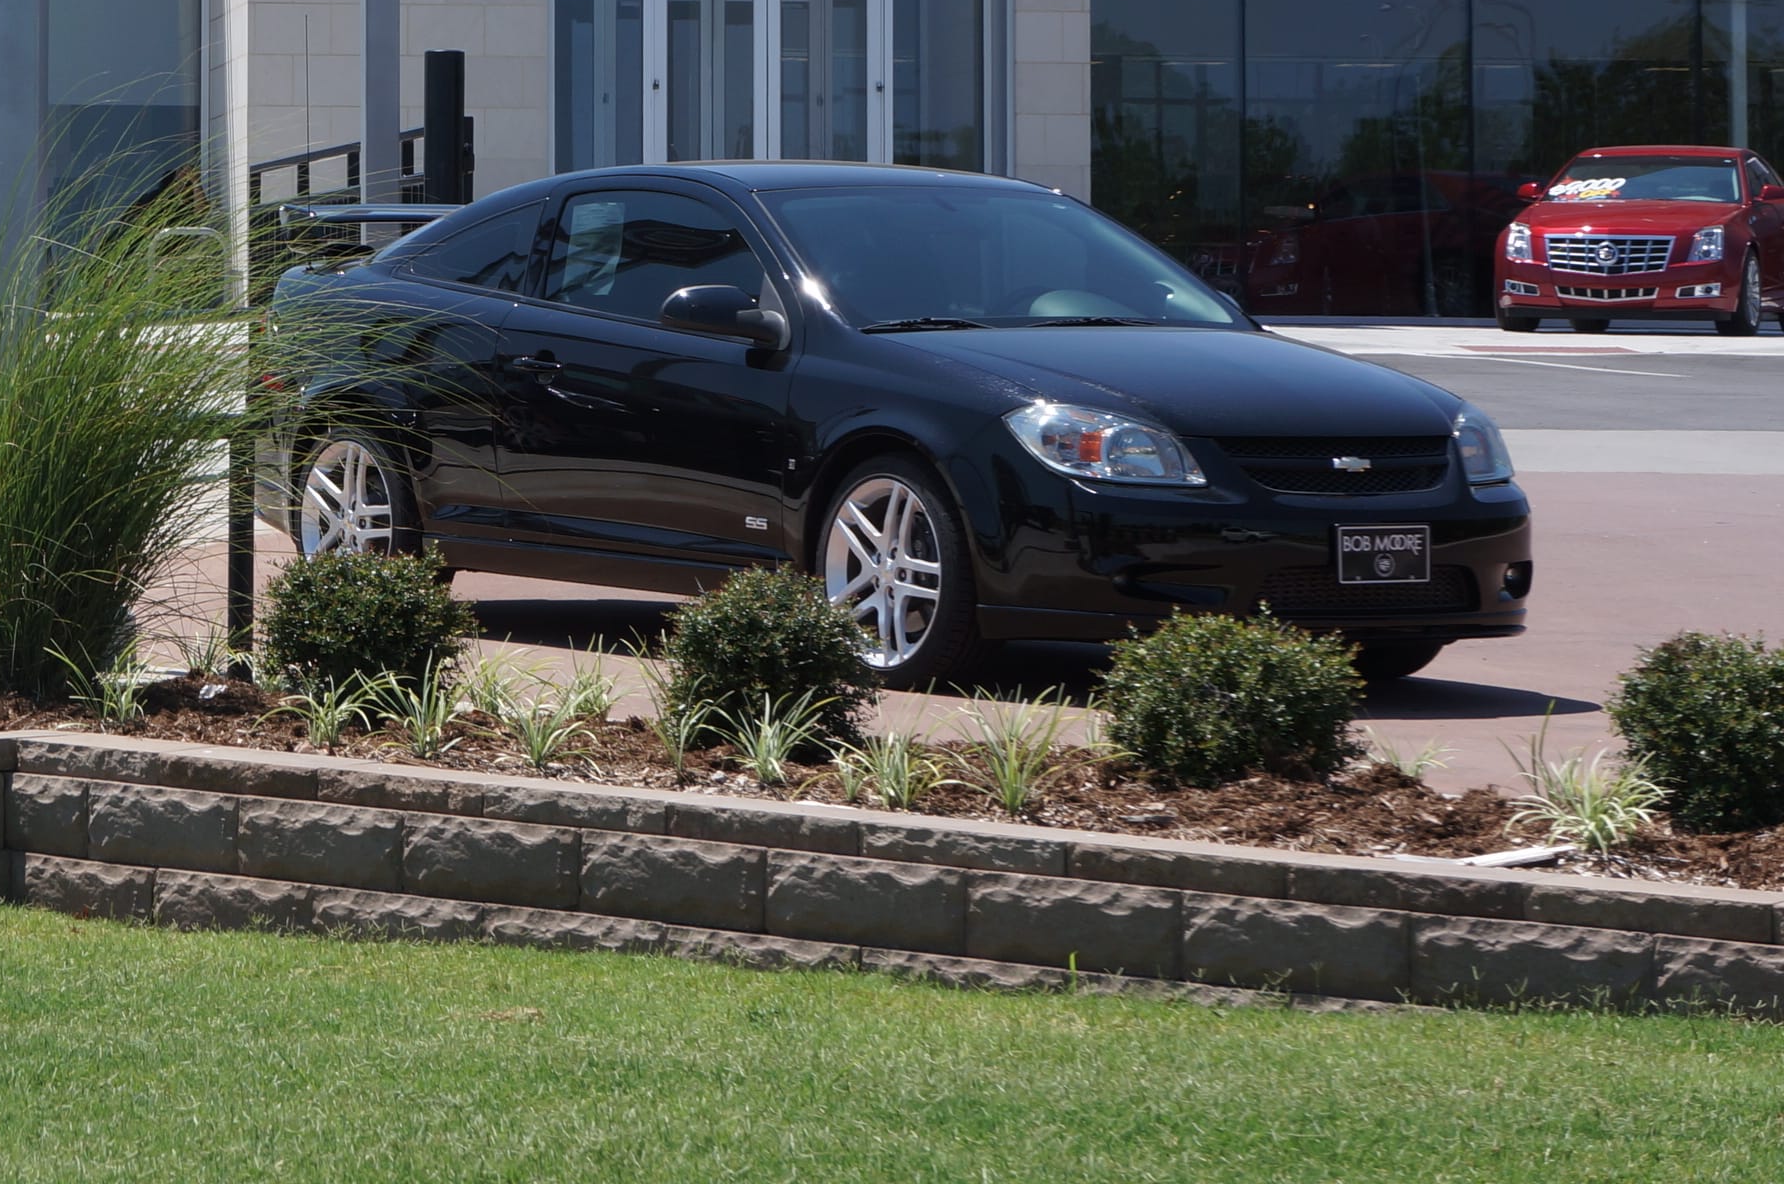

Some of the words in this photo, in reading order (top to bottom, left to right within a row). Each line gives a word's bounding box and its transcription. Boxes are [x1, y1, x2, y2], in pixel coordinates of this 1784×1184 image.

[745, 516, 769, 531] SS
[1342, 535, 1371, 552] BOB
[1373, 533, 1425, 556] MOORE
